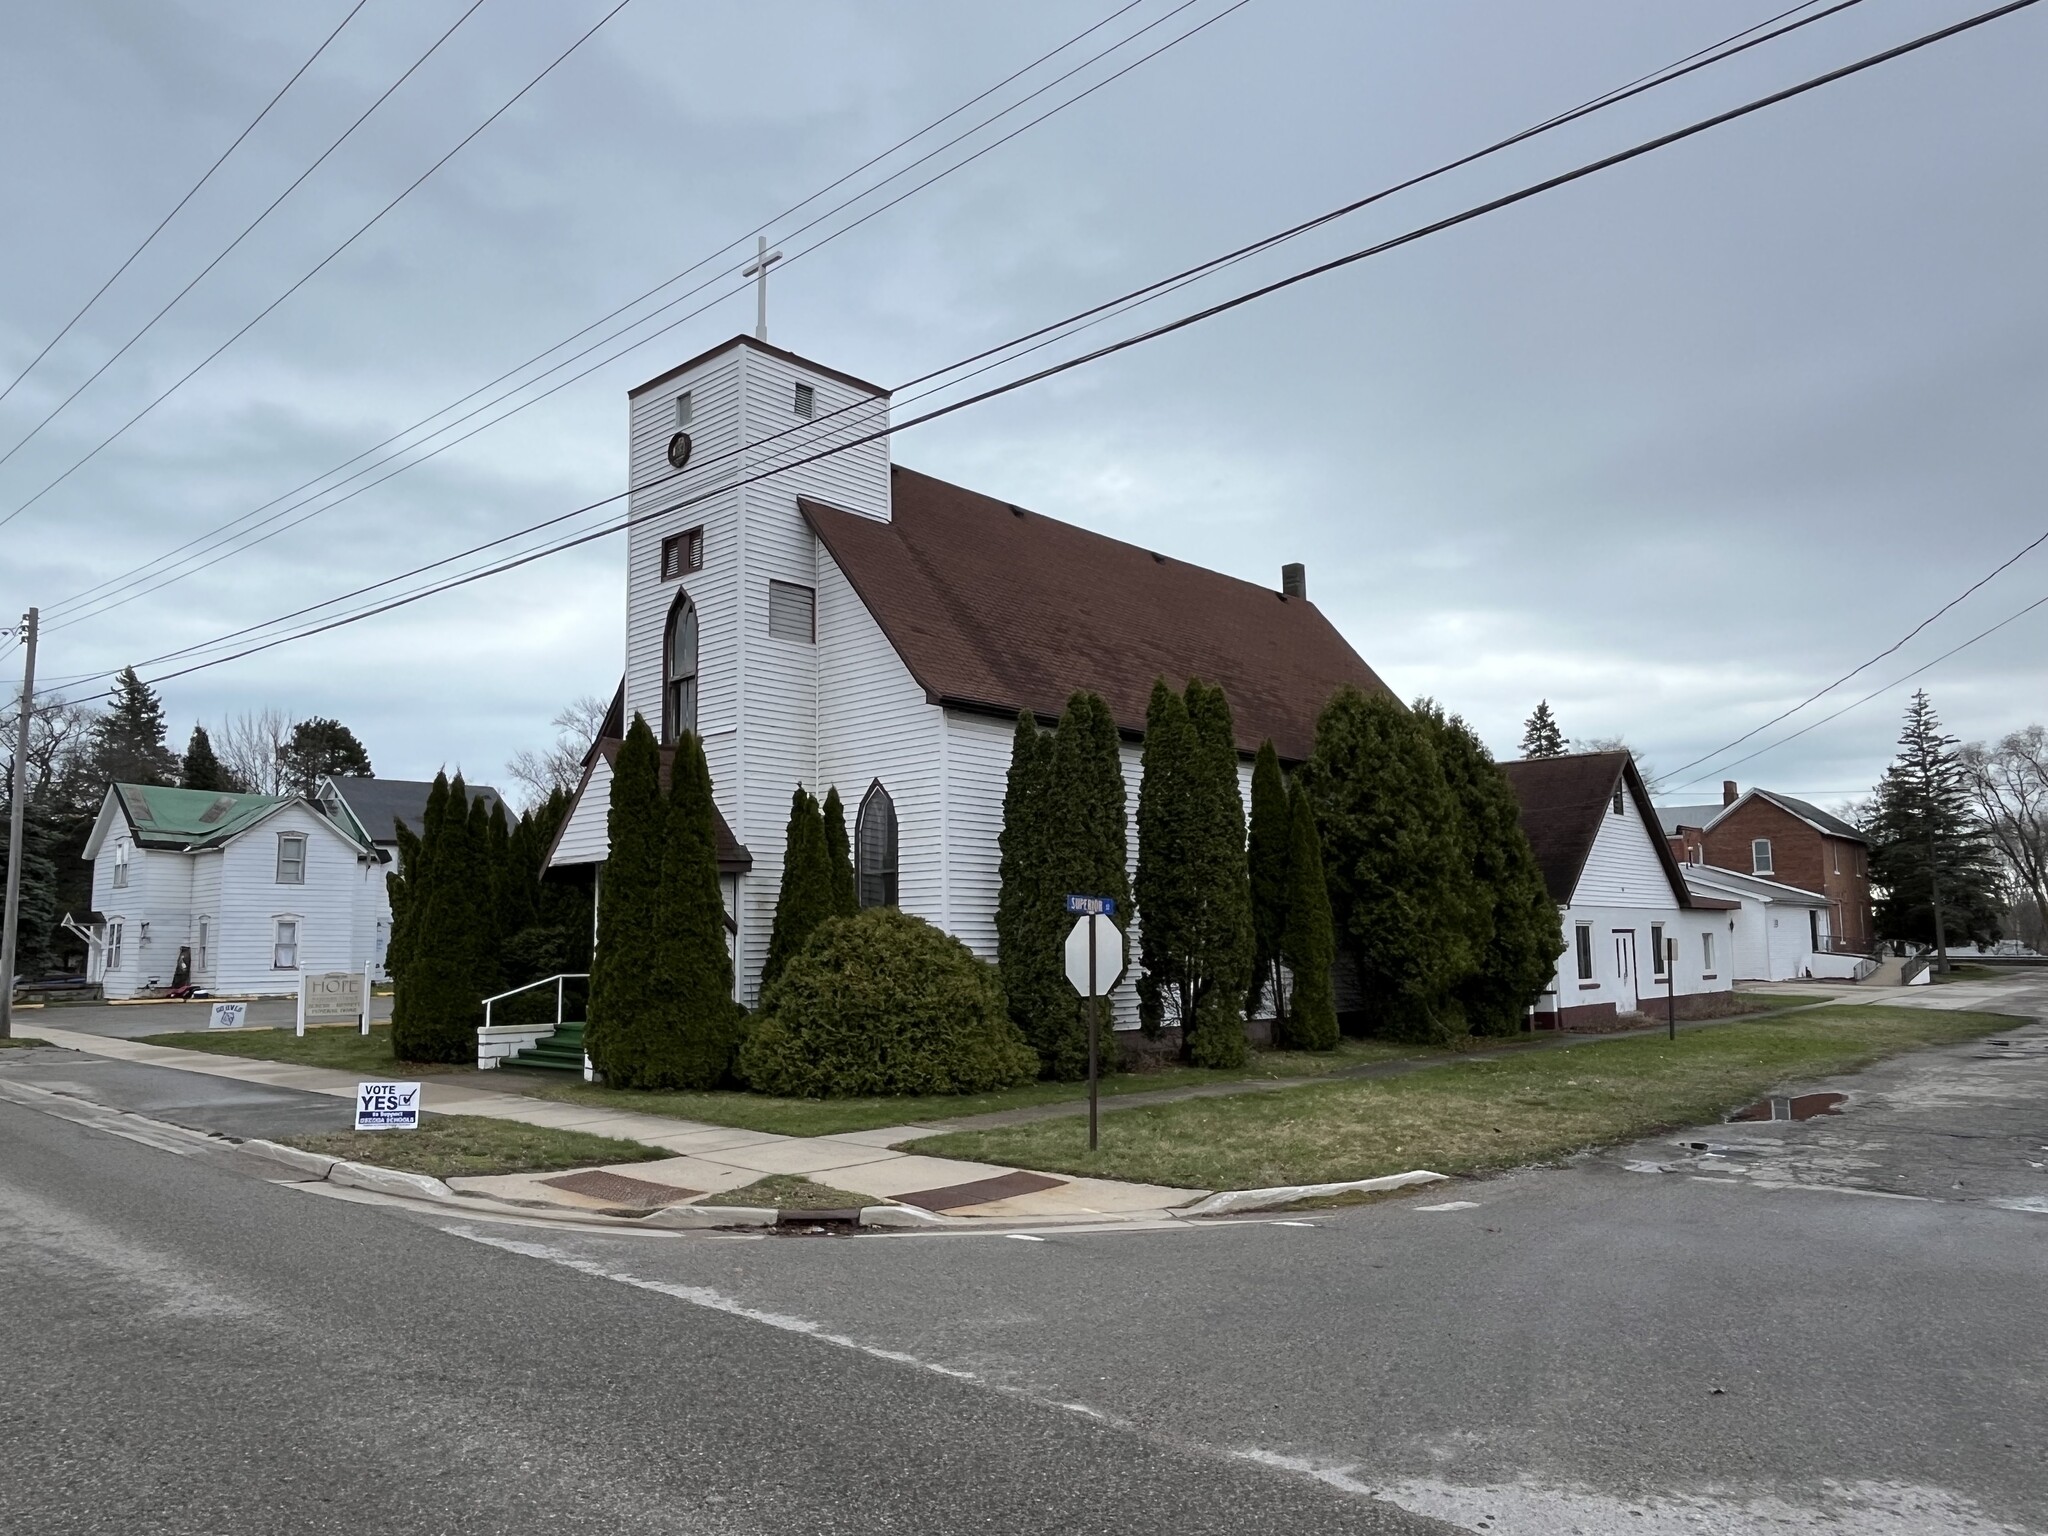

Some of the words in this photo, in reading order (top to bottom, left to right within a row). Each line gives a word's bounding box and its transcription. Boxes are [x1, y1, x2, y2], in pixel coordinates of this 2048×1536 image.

[1071, 897, 1103, 912] SUPERIOR
[312, 980, 359, 993] HOPE
[366, 1086, 396, 1094] VOTE
[361, 1096, 398, 1110] YES
